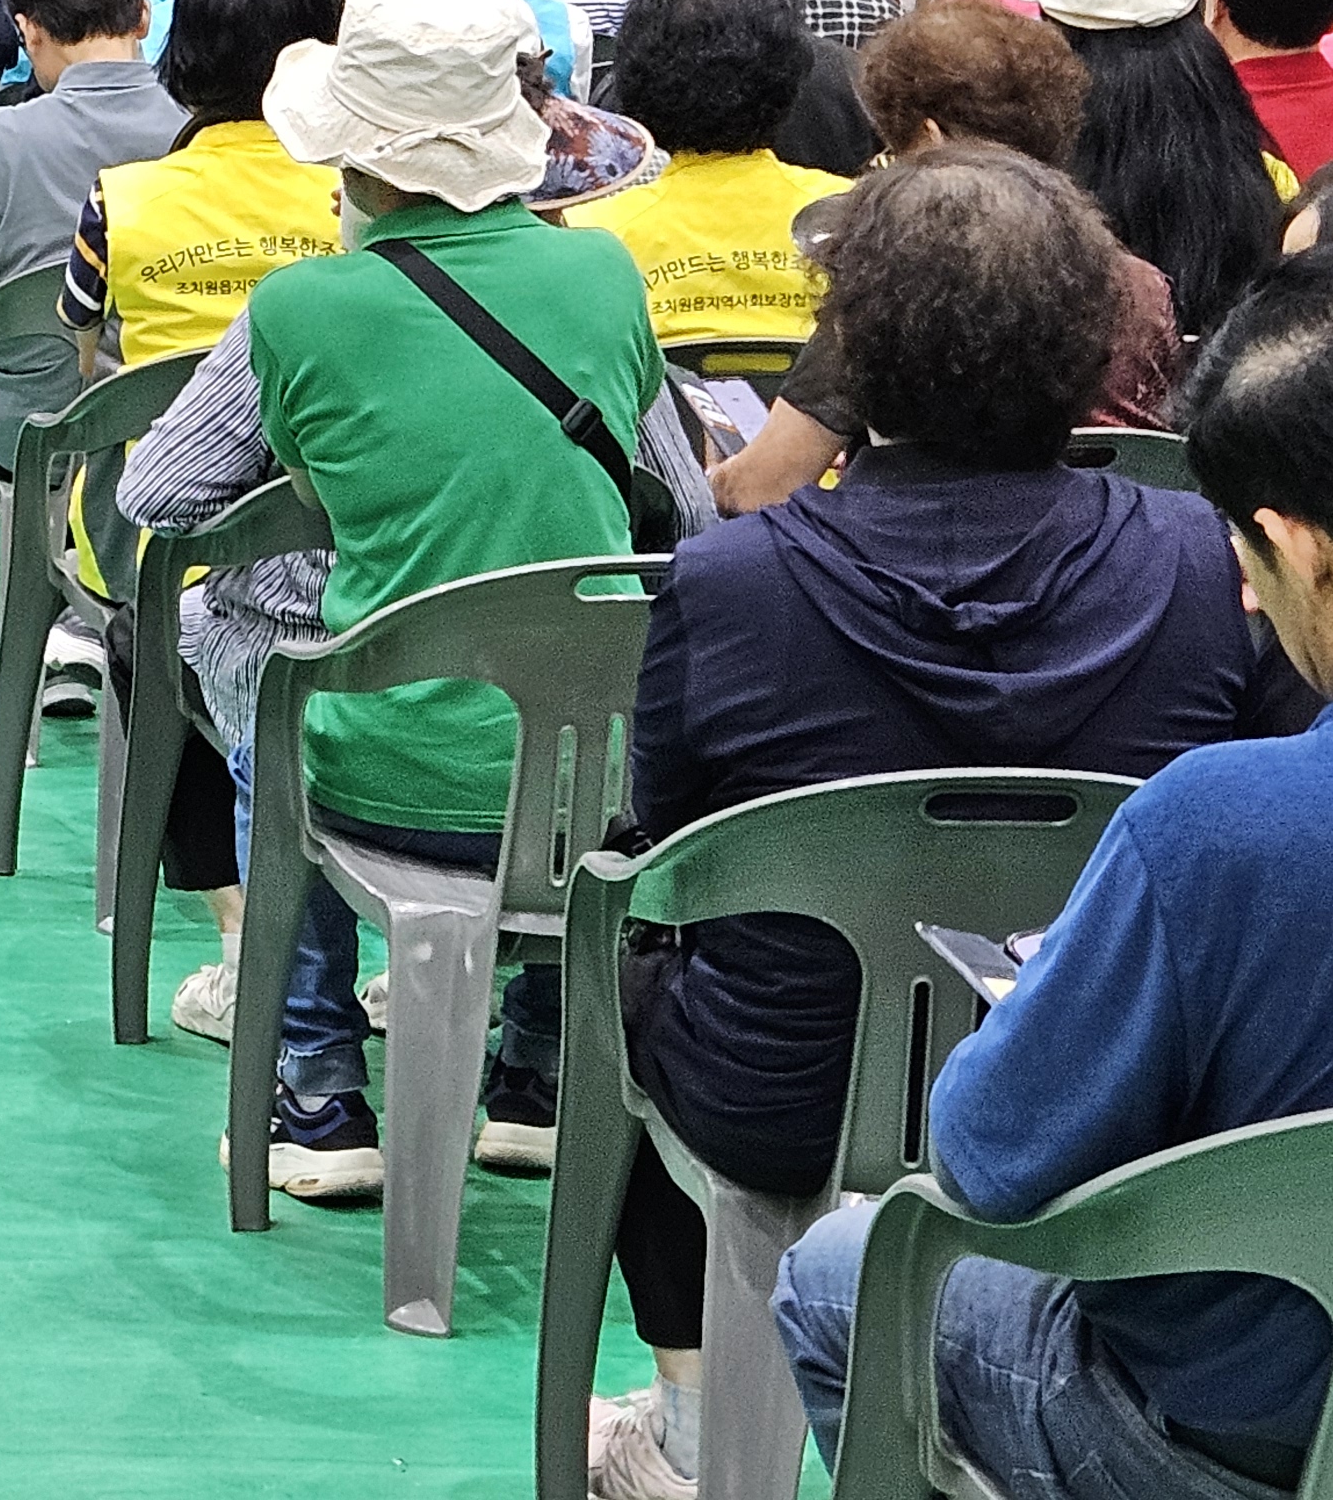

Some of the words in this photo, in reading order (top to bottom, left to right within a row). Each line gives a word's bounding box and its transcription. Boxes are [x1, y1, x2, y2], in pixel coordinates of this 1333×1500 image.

[139, 236, 254, 285] 우리가만드는
[259, 234, 349, 258] 행복한조
[643, 252, 727, 293] 가만드는
